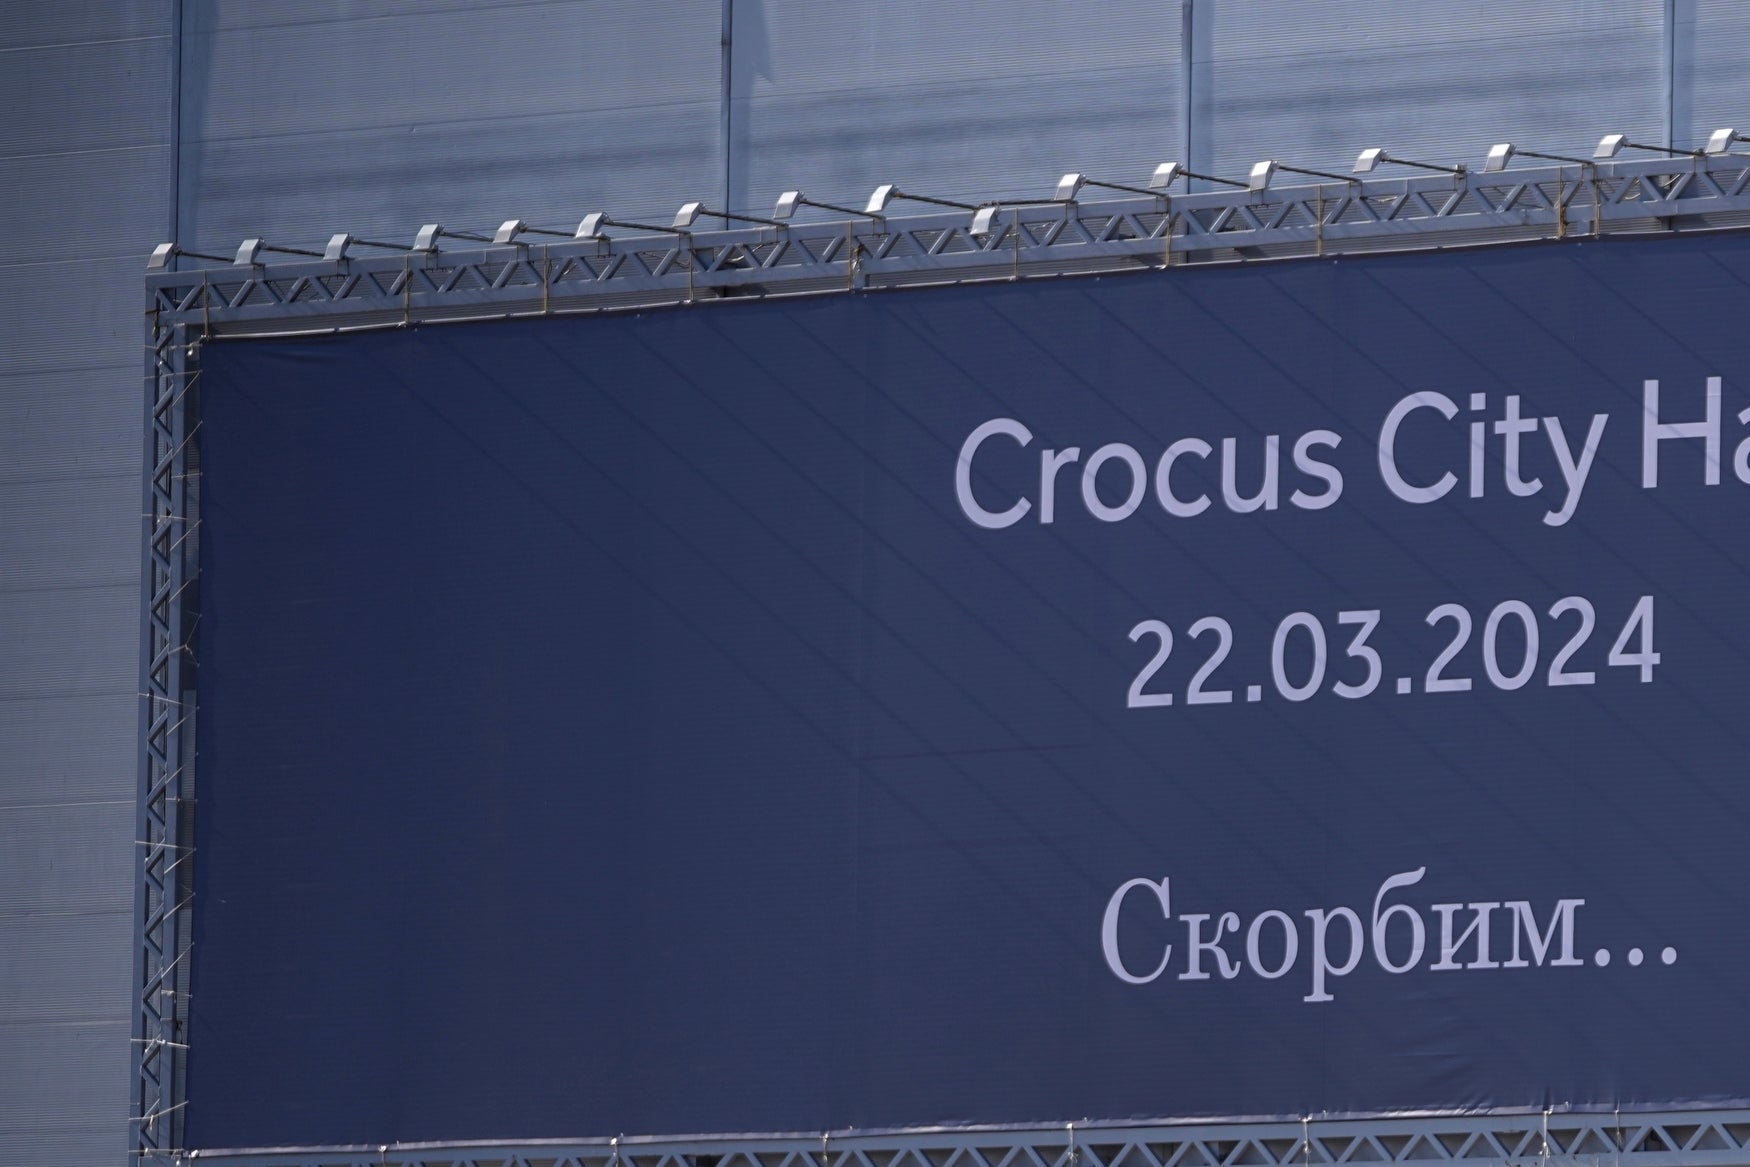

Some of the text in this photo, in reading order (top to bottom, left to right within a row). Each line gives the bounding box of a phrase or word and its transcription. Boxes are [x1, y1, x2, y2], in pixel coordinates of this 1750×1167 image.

[954, 418, 1344, 530] Crocus
[1378, 391, 1609, 527] City
[1127, 595, 1662, 708] 22.03.2024
[1102, 866, 1677, 1002] Скорбим...
